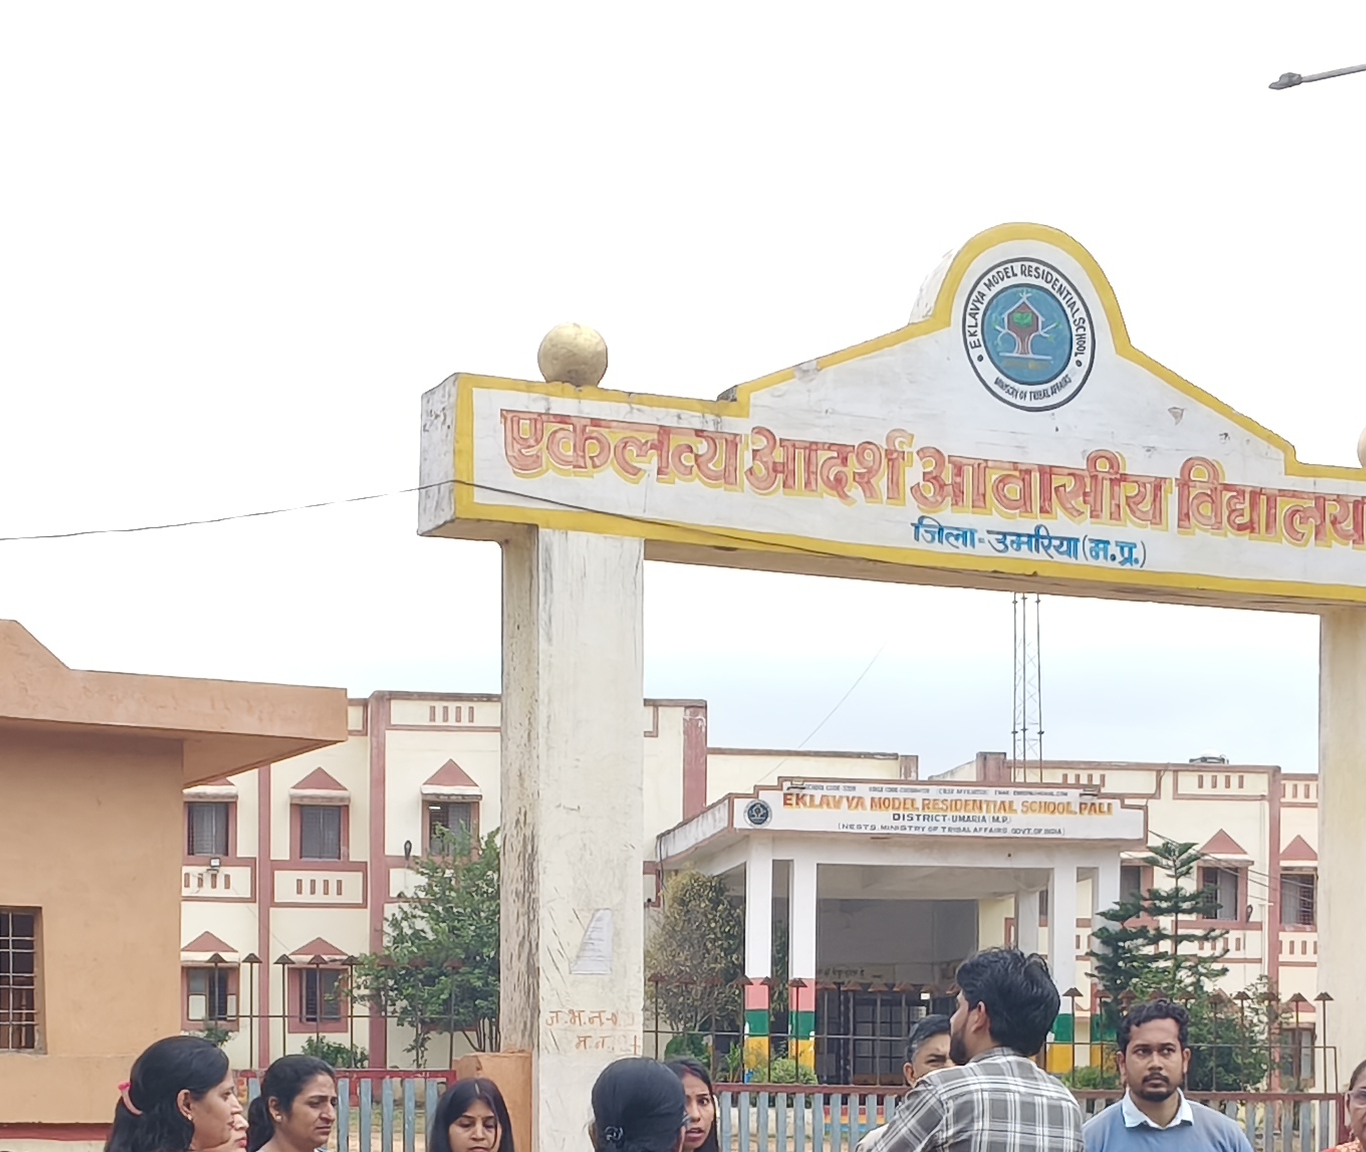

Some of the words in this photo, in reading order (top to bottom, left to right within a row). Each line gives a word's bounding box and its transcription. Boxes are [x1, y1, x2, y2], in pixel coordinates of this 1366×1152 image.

[967, 290, 986, 349] EKLAVYA
[983, 265, 1018, 291] MODEL
[1020, 263, 1081, 318] RESIDENTIAL
[1073, 317, 1087, 357] SCHOOL
[500, 409, 743, 490] एकलव्य
[744, 426, 913, 506] आदर्श
[910, 446, 1172, 530] आवासीय
[783, 793, 866, 810] EKLAVYA
[870, 796, 919, 812] MODEL
[921, 798, 1017, 814] RESIDENTIAL
[1079, 802, 1113, 816] PALI
